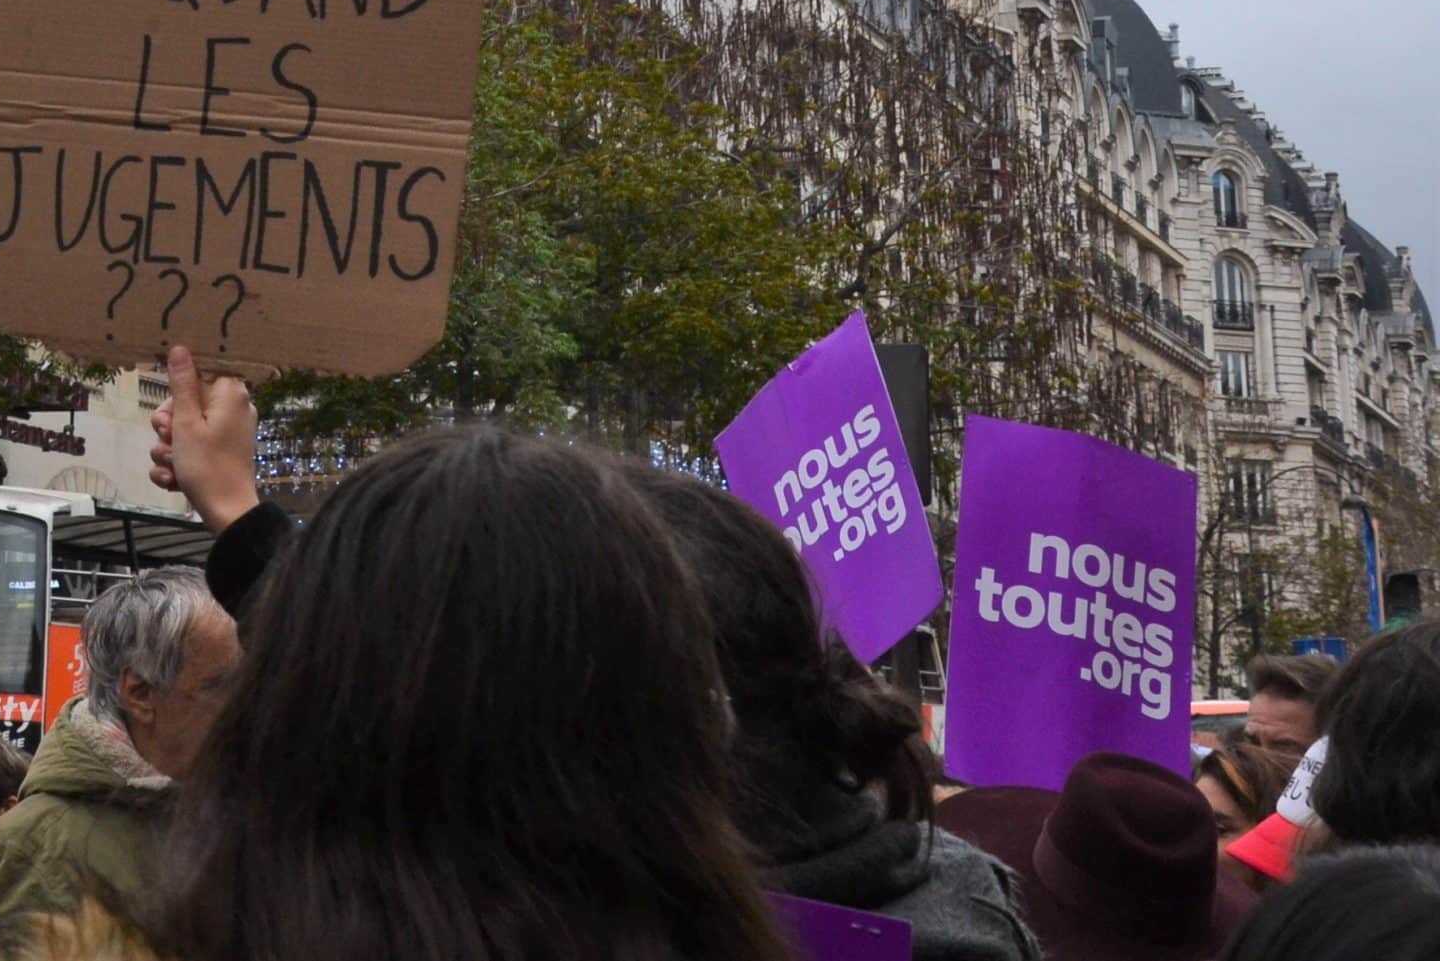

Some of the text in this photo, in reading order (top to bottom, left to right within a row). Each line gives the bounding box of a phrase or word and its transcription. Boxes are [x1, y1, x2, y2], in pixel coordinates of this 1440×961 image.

[134, 35, 319, 143] LES
[773, 404, 881, 517] nous
[782, 447, 895, 556] outes
[833, 482, 907, 562] .org
[1028, 531, 1177, 613] nous
[974, 566, 1174, 668] toutes
[1080, 650, 1172, 721] .org
